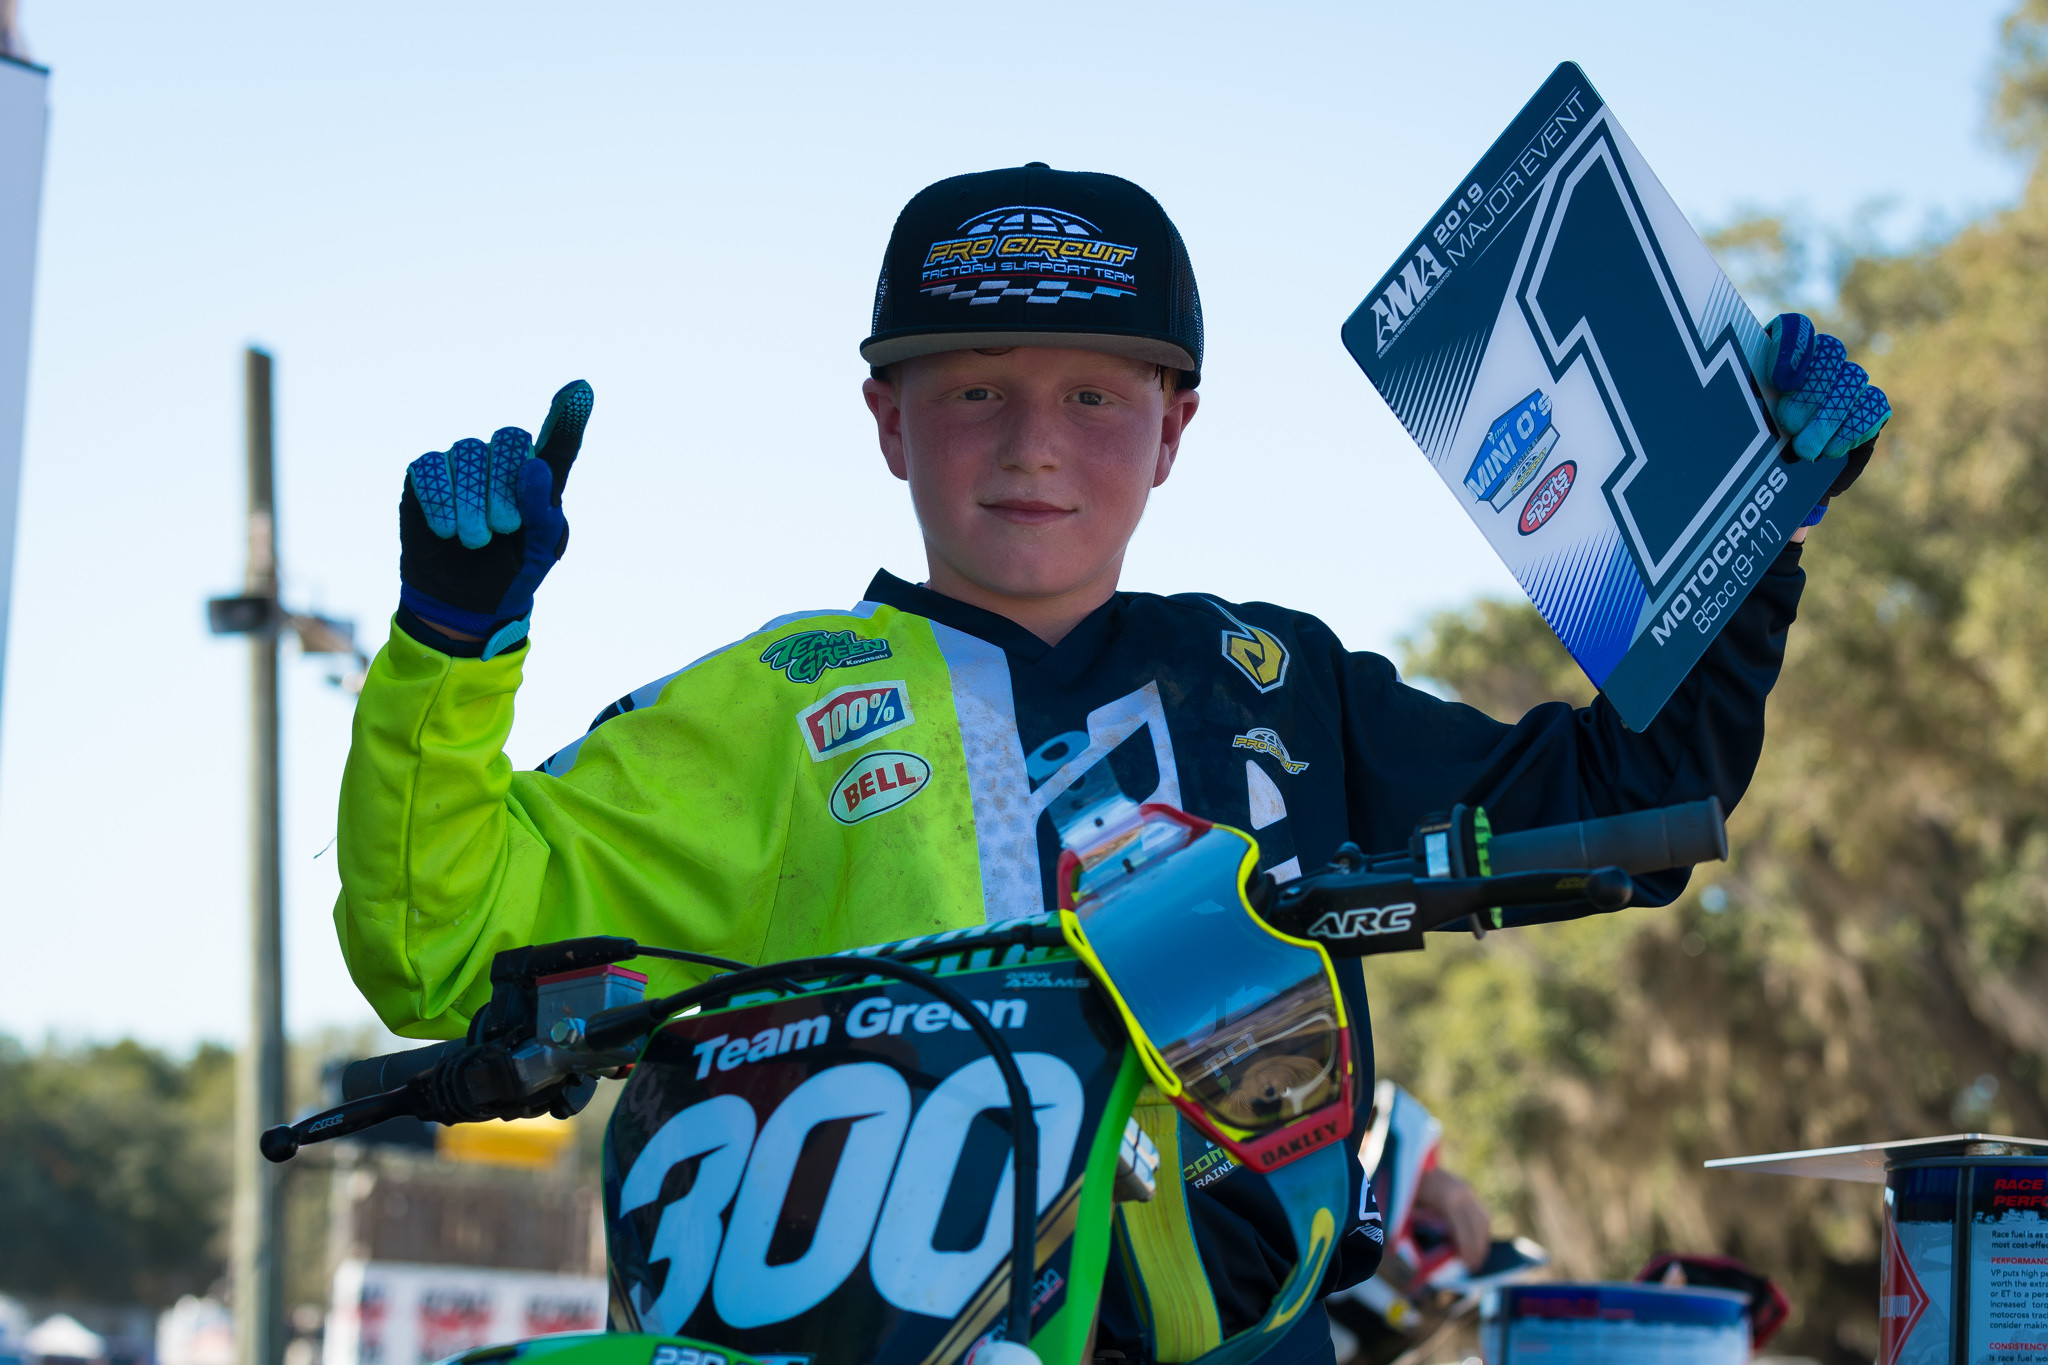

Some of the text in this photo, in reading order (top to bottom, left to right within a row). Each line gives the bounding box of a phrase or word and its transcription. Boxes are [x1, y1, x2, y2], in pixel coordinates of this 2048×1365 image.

[1446, 90, 1585, 266] MAJOR EVENT
[1433, 183, 1483, 245] 2019
[924, 235, 1137, 267] PRO CIRCUIT
[922, 260, 1135, 284] FACTORY SUPPORT TEAM
[1370, 243, 1448, 354] AMA
[1378, 269, 1453, 359] AMERICAN MOTORCYCLIST ASSOCIATION
[1522, 132, 1775, 588] 1
[1466, 432, 1517, 497] MINI
[1504, 445, 1532, 483] PRESENTED
[1651, 466, 1788, 647] MOTOCROSS
[1692, 580, 1738, 634] 85cc
[762, 631, 851, 667] TEAM
[793, 639, 885, 680] GREEN
[846, 653, 889, 666] Kawasaki
[817, 690, 895, 748] 100%
[1233, 735, 1267, 752] PRO
[843, 762, 916, 813] BELL
[1307, 902, 1417, 940] ARC
[693, 1015, 831, 1081] Team
[308, 1114, 344, 1134] ARC
[1260, 1120, 1339, 1166] OAKLEY
[619, 1051, 1085, 1337] 300
[1994, 1179, 2045, 1191] RACE
[1991, 1230, 2010, 1238] Race
[2011, 1230, 2026, 1238] fuel
[2027, 1230, 2034, 1238] is
[1991, 1241, 2010, 1249] most
[1990, 1269, 2001, 1277] VP
[2002, 1270, 2020, 1279] puts
[2021, 1268, 2038, 1279] high
[1990, 1279, 2012, 1287] worth
[2014, 1279, 2027, 1287] the
[1990, 1300, 2026, 1308] Increased
[2001, 1290, 2011, 1298] ET
[1989, 1311, 2030, 1319] motocross
[1989, 1321, 2022, 1329] consider
[1989, 1342, 2048, 1351] CONSISTENCY
[2017, 1354, 2033, 1362] fuel
